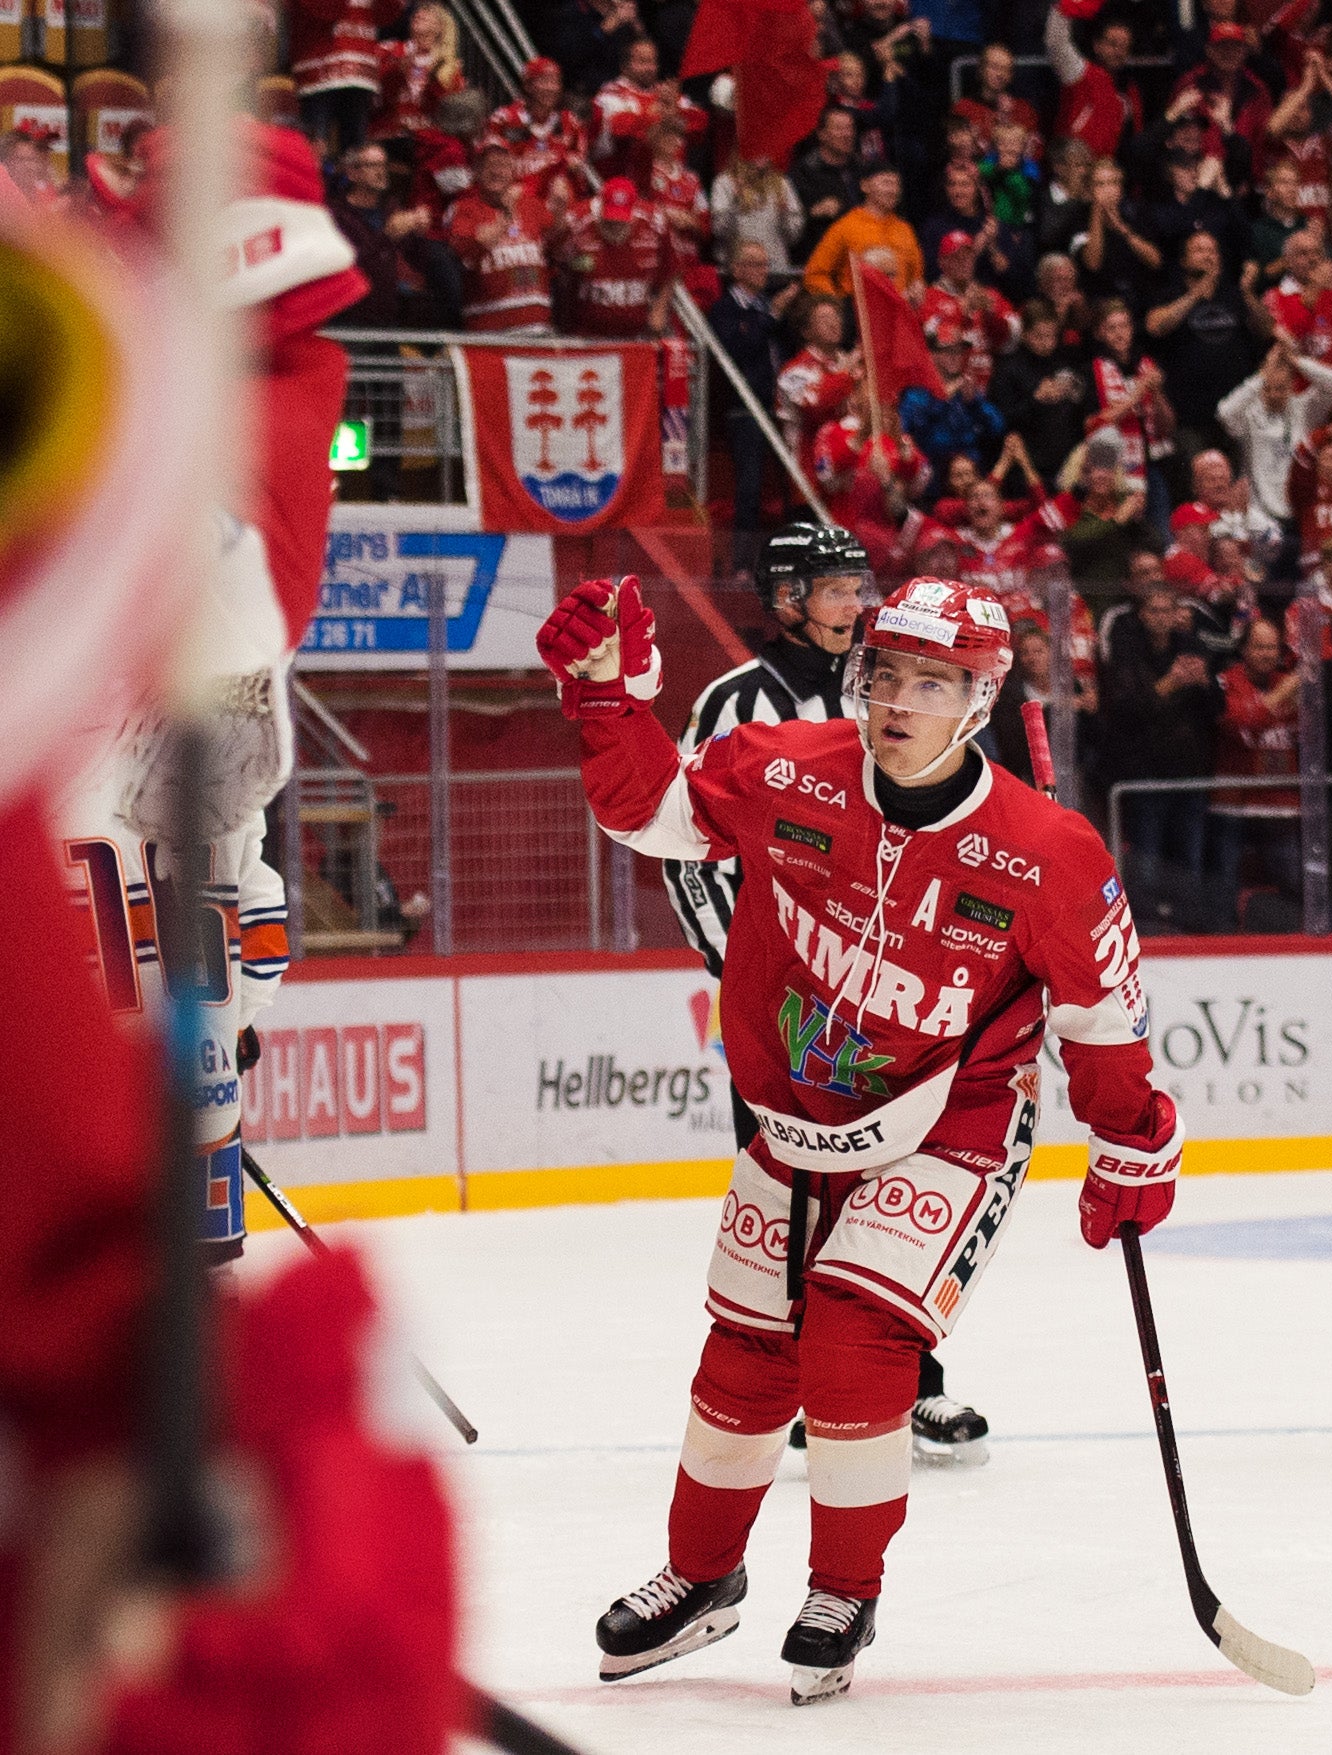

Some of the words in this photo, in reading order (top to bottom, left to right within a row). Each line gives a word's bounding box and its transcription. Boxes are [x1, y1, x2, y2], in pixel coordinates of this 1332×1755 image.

[797, 774, 847, 810] SCA
[990, 850, 1042, 887] SCA
[910, 877, 942, 933] A
[771, 875, 976, 1038] TIMRÅ
[941, 924, 1008, 953] JOWIC
[777, 985, 896, 1100] NHK
[1146, 995, 1311, 1070] oVis
[241, 1033, 424, 1127] UHAUS
[536, 1054, 712, 1120] Hellbergs
[722, 1195, 790, 1256] LBM
[853, 1181, 948, 1230] LBM
[948, 1098, 1038, 1294] PEAB
